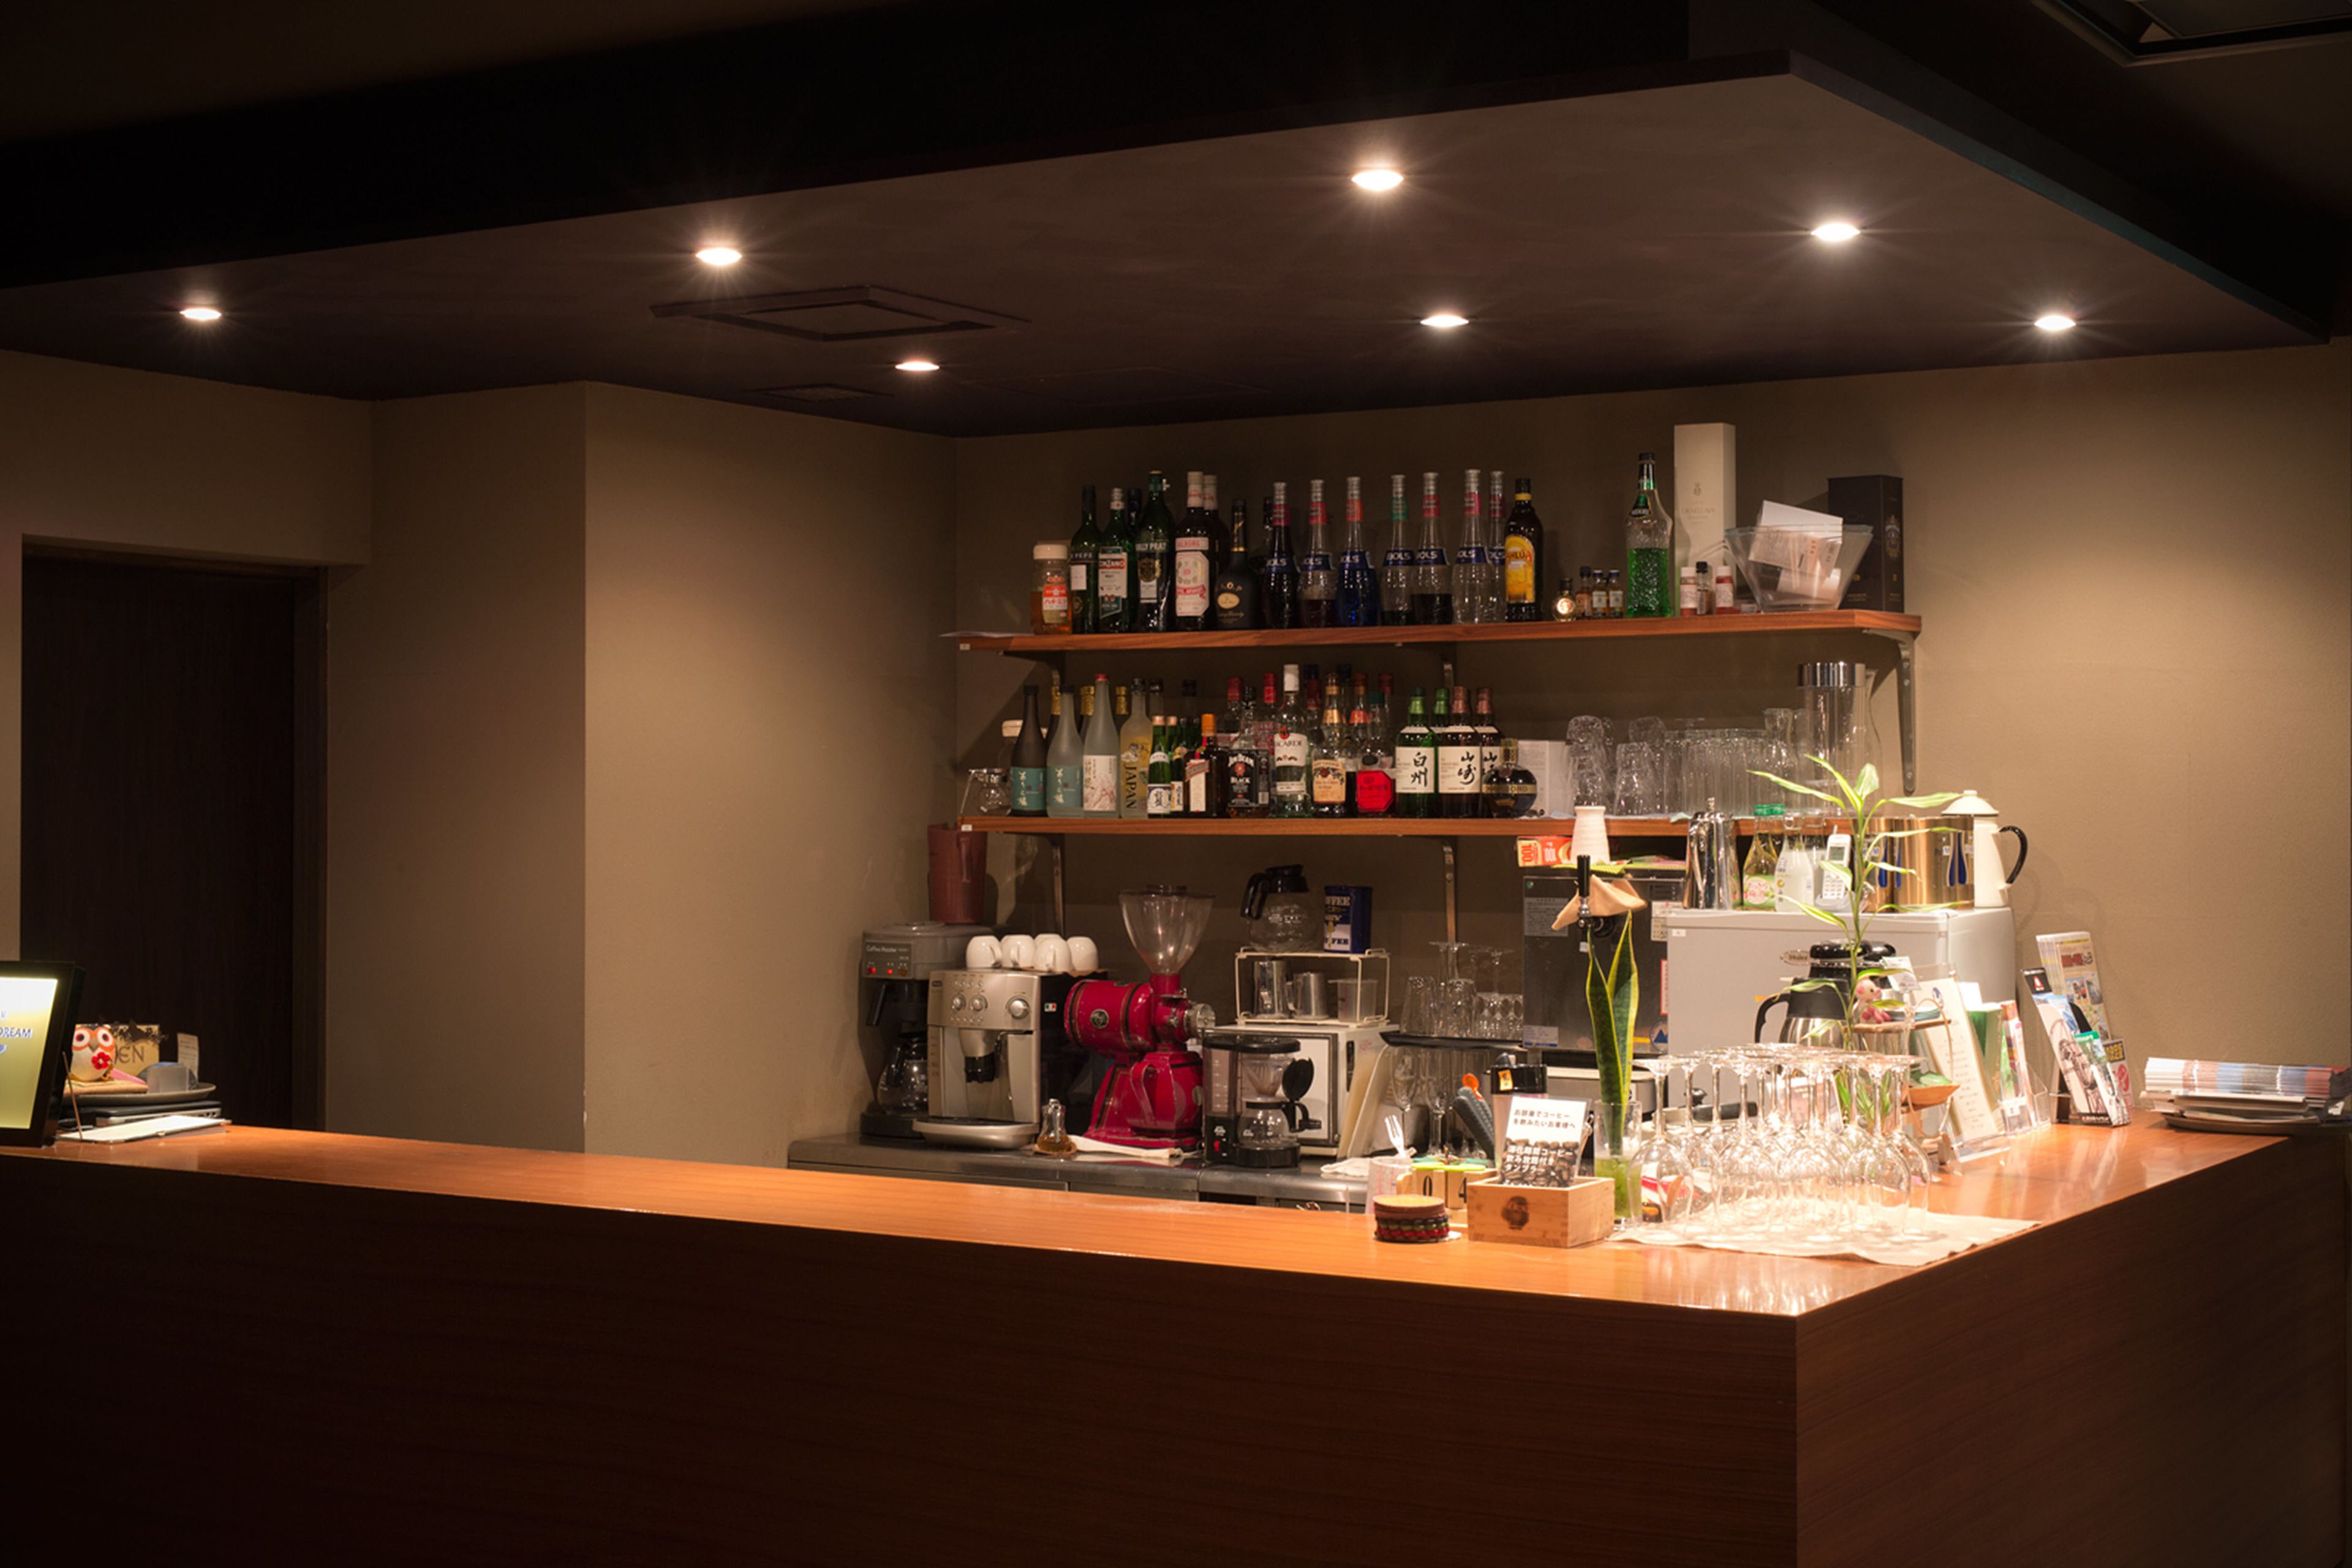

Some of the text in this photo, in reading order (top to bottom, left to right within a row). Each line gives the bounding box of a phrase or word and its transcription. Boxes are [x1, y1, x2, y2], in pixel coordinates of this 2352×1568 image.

[1386, 551, 1411, 561] BOLS
[1411, 752, 1428, 788] 白州
[1457, 751, 1477, 785] 山崎
[1123, 762, 1137, 810] JAPAN
[1231, 776, 1251, 785] BLACK
[1521, 843, 1532, 862] 100
[1514, 1109, 1570, 1119] お部屋でコーヒー
[1513, 1118, 1575, 1129] を飲みたいお客様へ
[1505, 1164, 1545, 1174] タンブラー
